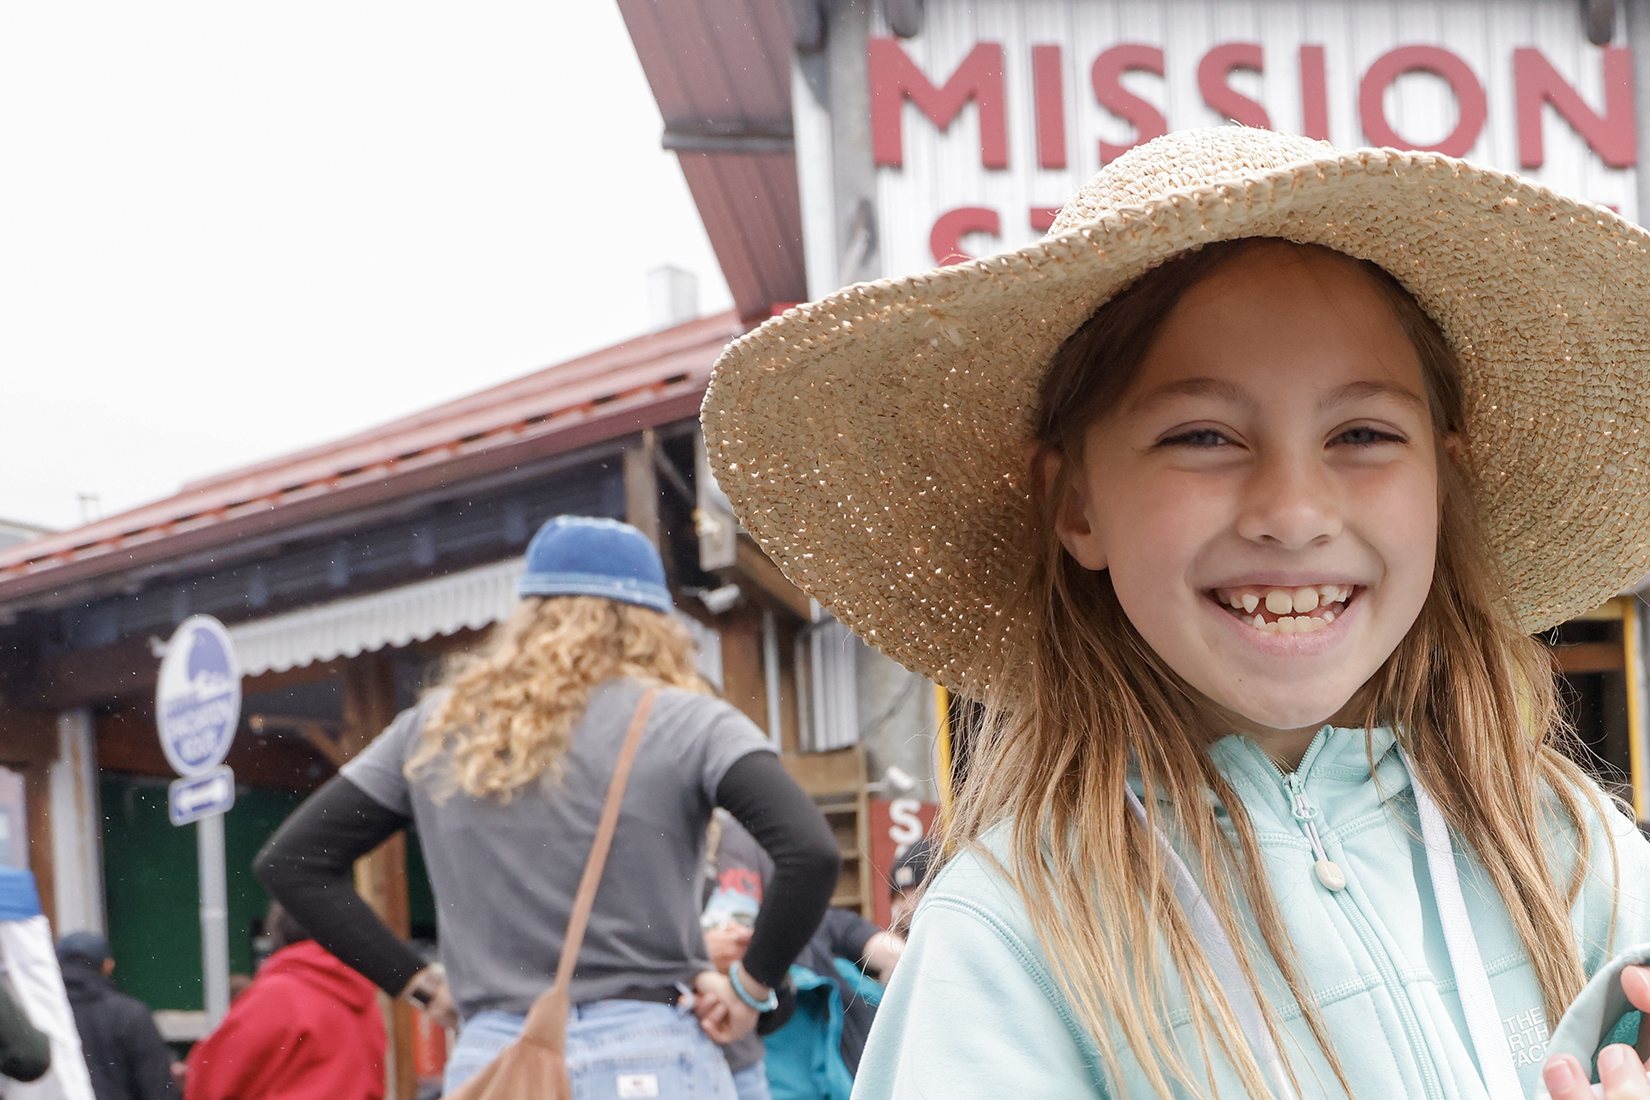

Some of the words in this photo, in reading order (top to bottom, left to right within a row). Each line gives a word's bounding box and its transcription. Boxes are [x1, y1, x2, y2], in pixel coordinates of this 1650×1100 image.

[869, 35, 1637, 170] MISSION
[1502, 1006, 1546, 1035] THE
[1507, 1023, 1551, 1053] RTH
